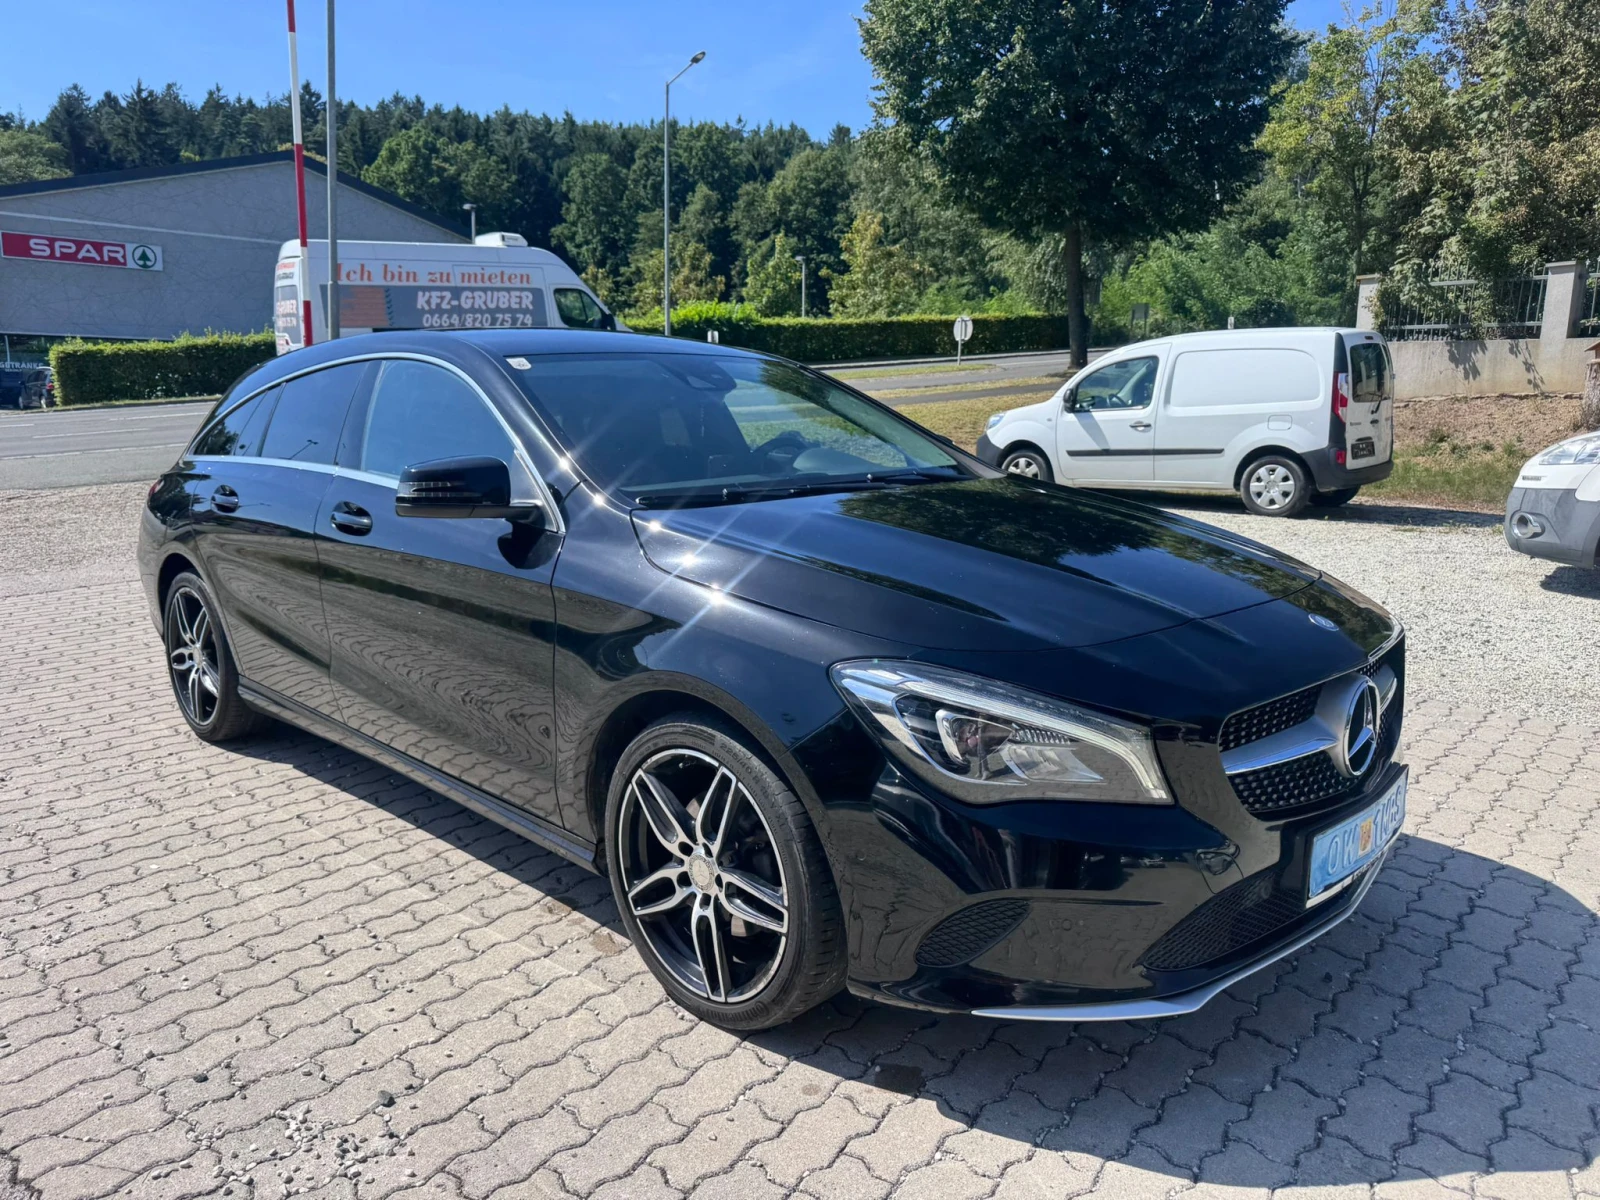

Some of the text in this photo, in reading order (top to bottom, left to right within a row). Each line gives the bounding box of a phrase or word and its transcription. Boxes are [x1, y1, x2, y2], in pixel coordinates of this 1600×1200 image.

[29, 238, 125, 263] SPAR
[336, 263, 531, 285] Ich bin zu mieten
[416, 290, 533, 310] KFZ-GRUBER
[423, 313, 533, 328] 0664/820 75 74
